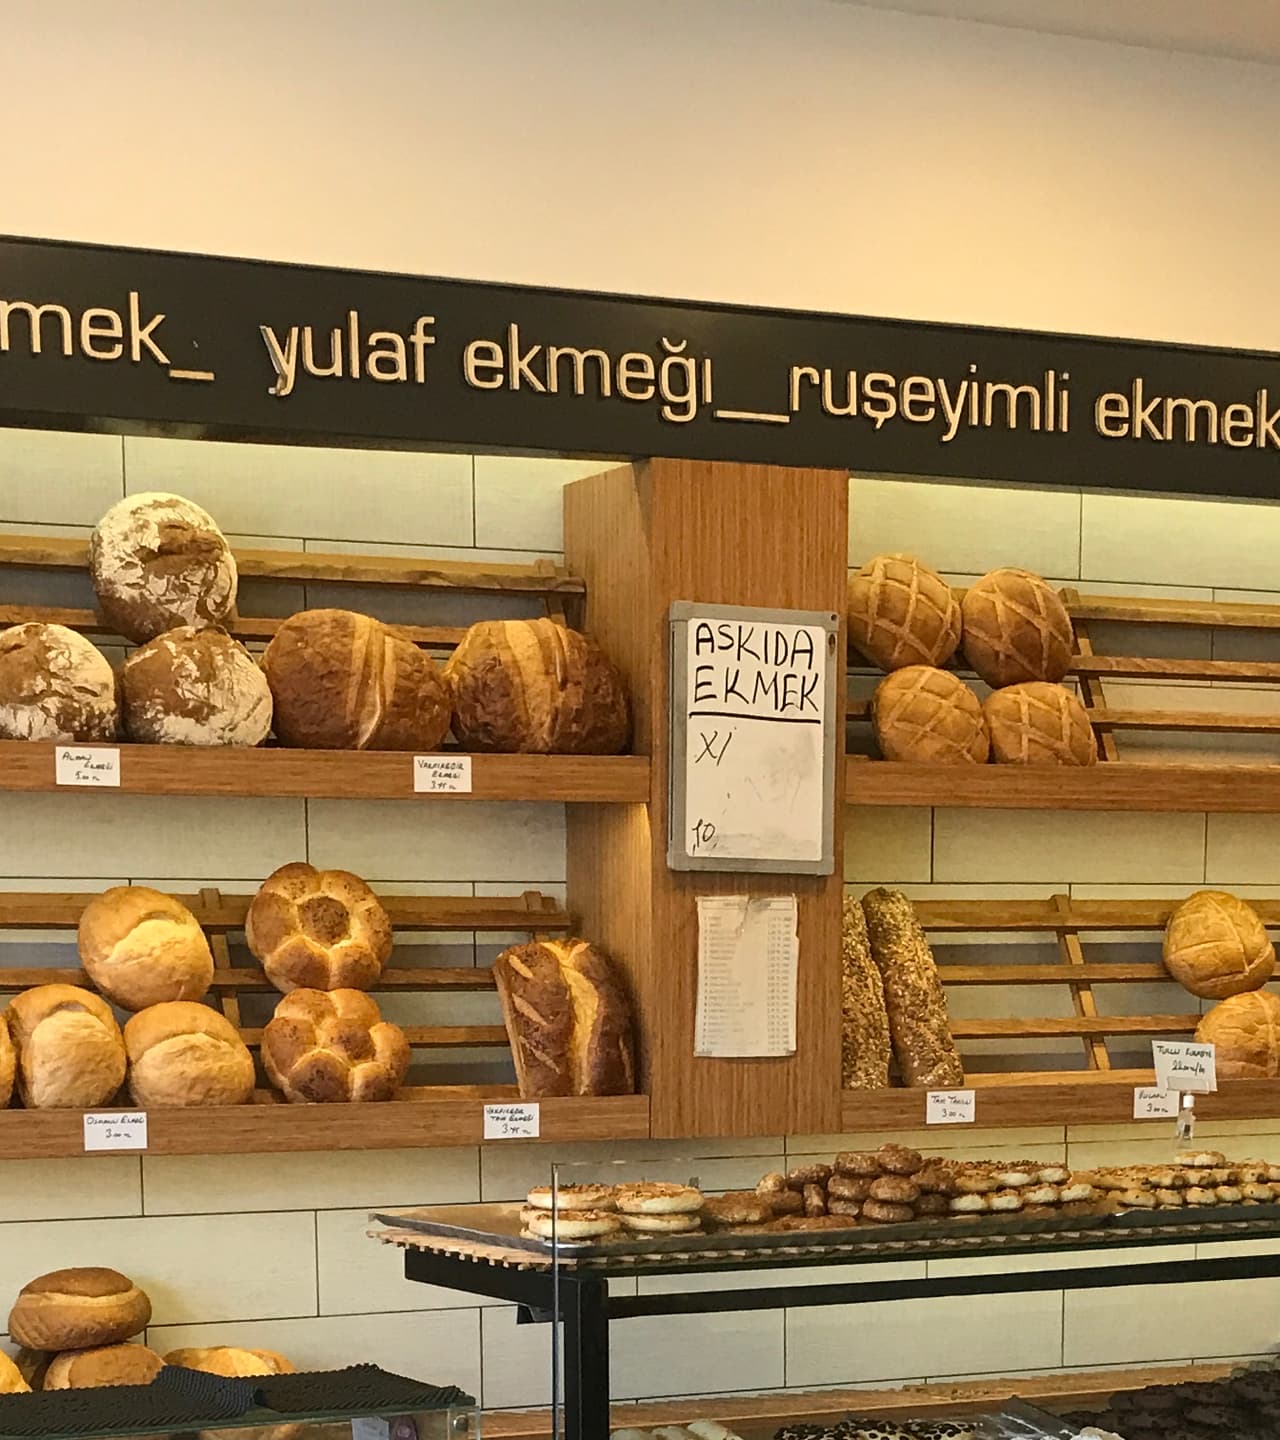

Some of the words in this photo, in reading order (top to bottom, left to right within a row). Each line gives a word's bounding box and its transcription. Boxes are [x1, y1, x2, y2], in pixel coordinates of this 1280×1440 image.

[259, 310, 436, 396] yulaf
[695, 622, 814, 670] ASKIDA
[694, 665, 819, 713] EKMEK
